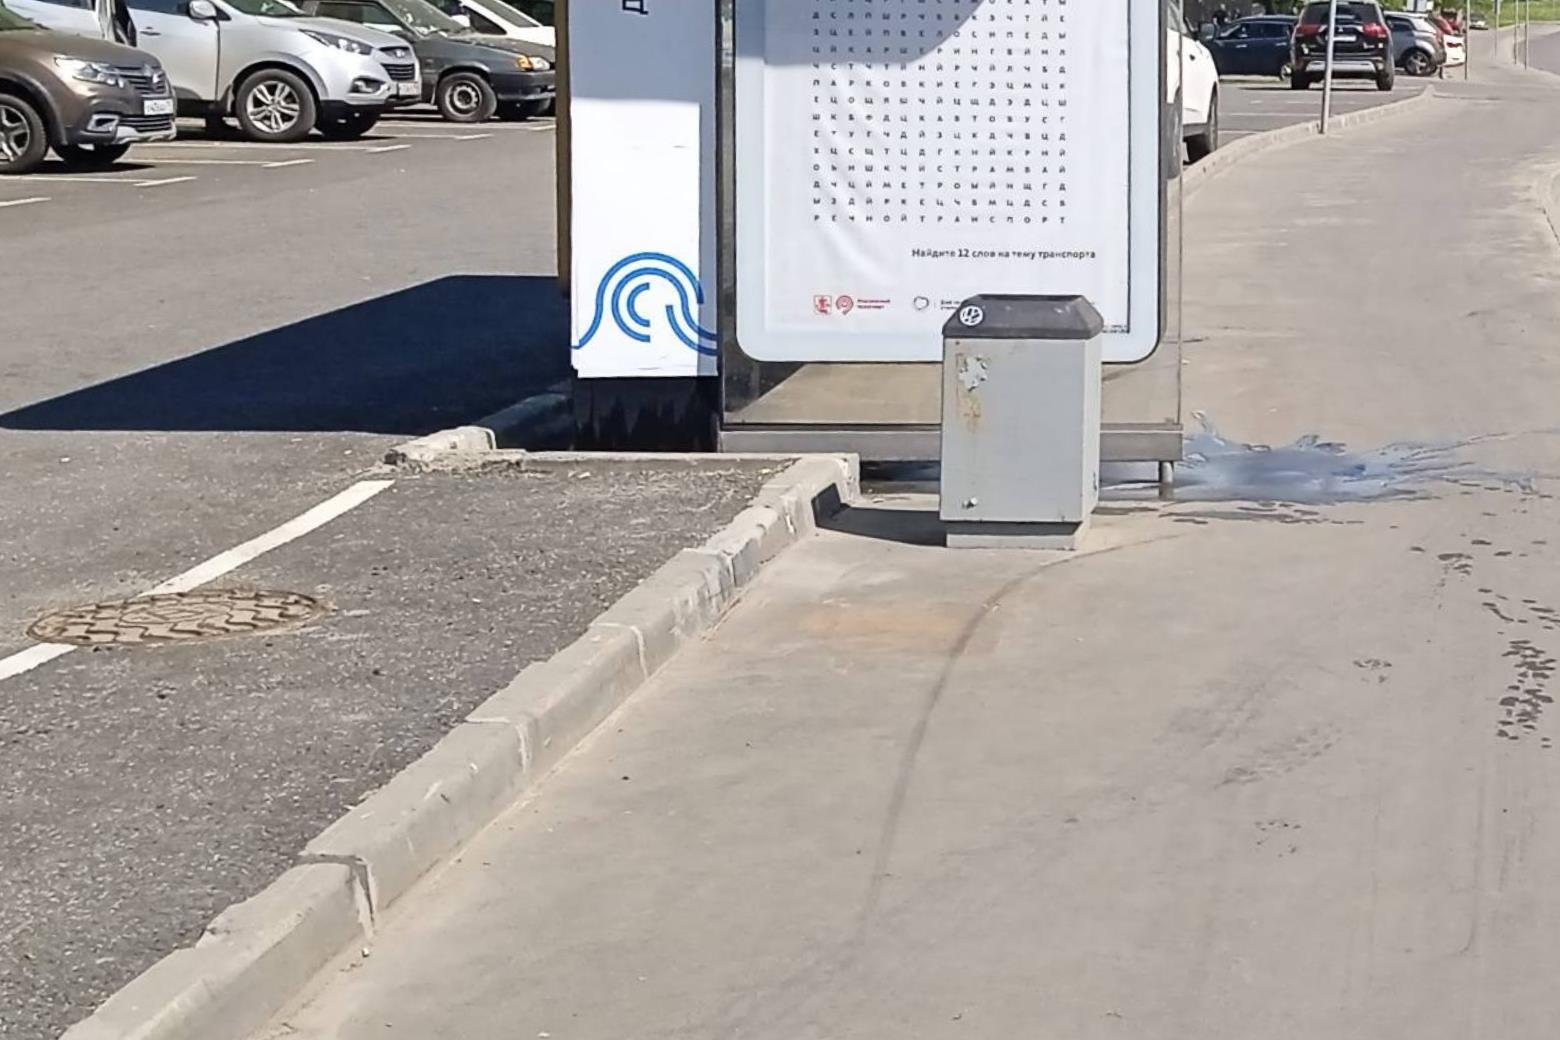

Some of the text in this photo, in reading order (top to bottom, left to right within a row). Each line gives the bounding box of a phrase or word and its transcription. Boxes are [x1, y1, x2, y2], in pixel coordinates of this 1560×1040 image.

[912, 248, 956, 258] Найдите
[957, 248, 970, 258] 12
[971, 250, 996, 258] слов
[1011, 251, 1036, 260] тему
[1038, 251, 1096, 260] транспорта
